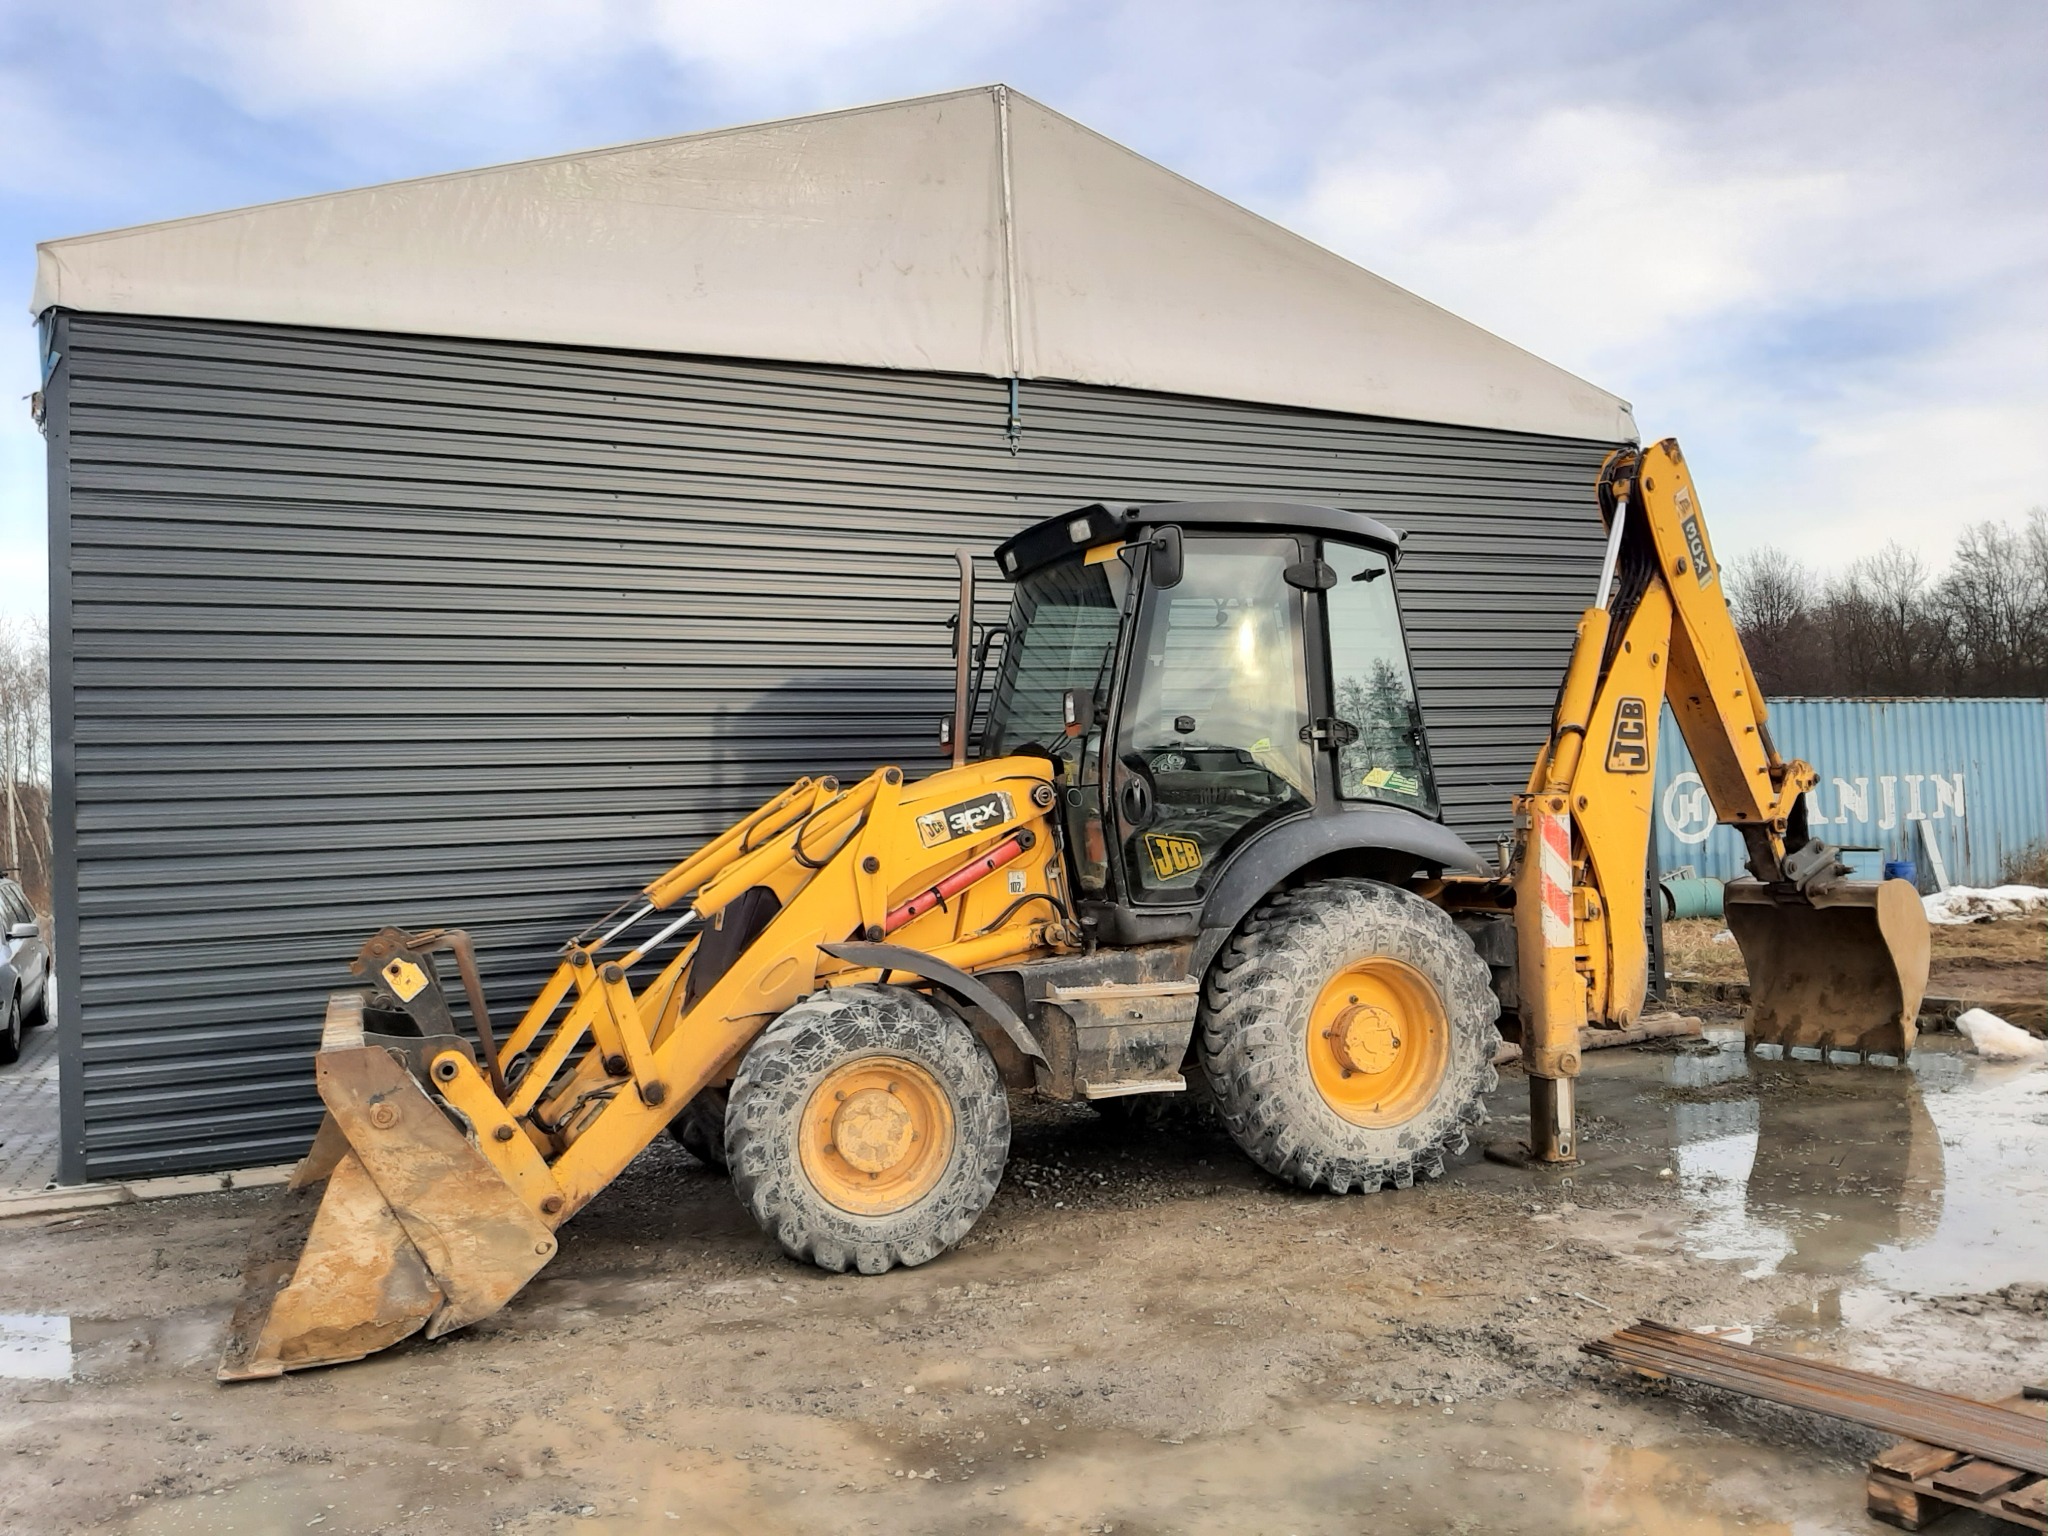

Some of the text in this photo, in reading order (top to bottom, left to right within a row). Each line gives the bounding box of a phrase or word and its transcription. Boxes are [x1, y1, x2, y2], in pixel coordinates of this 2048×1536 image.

[1613, 703, 1646, 766] JCB
[1776, 773, 1966, 830] NJIN
[925, 821, 945, 838] JCB
[1155, 838, 1199, 876] JCB
[1010, 881, 1022, 893] 102
